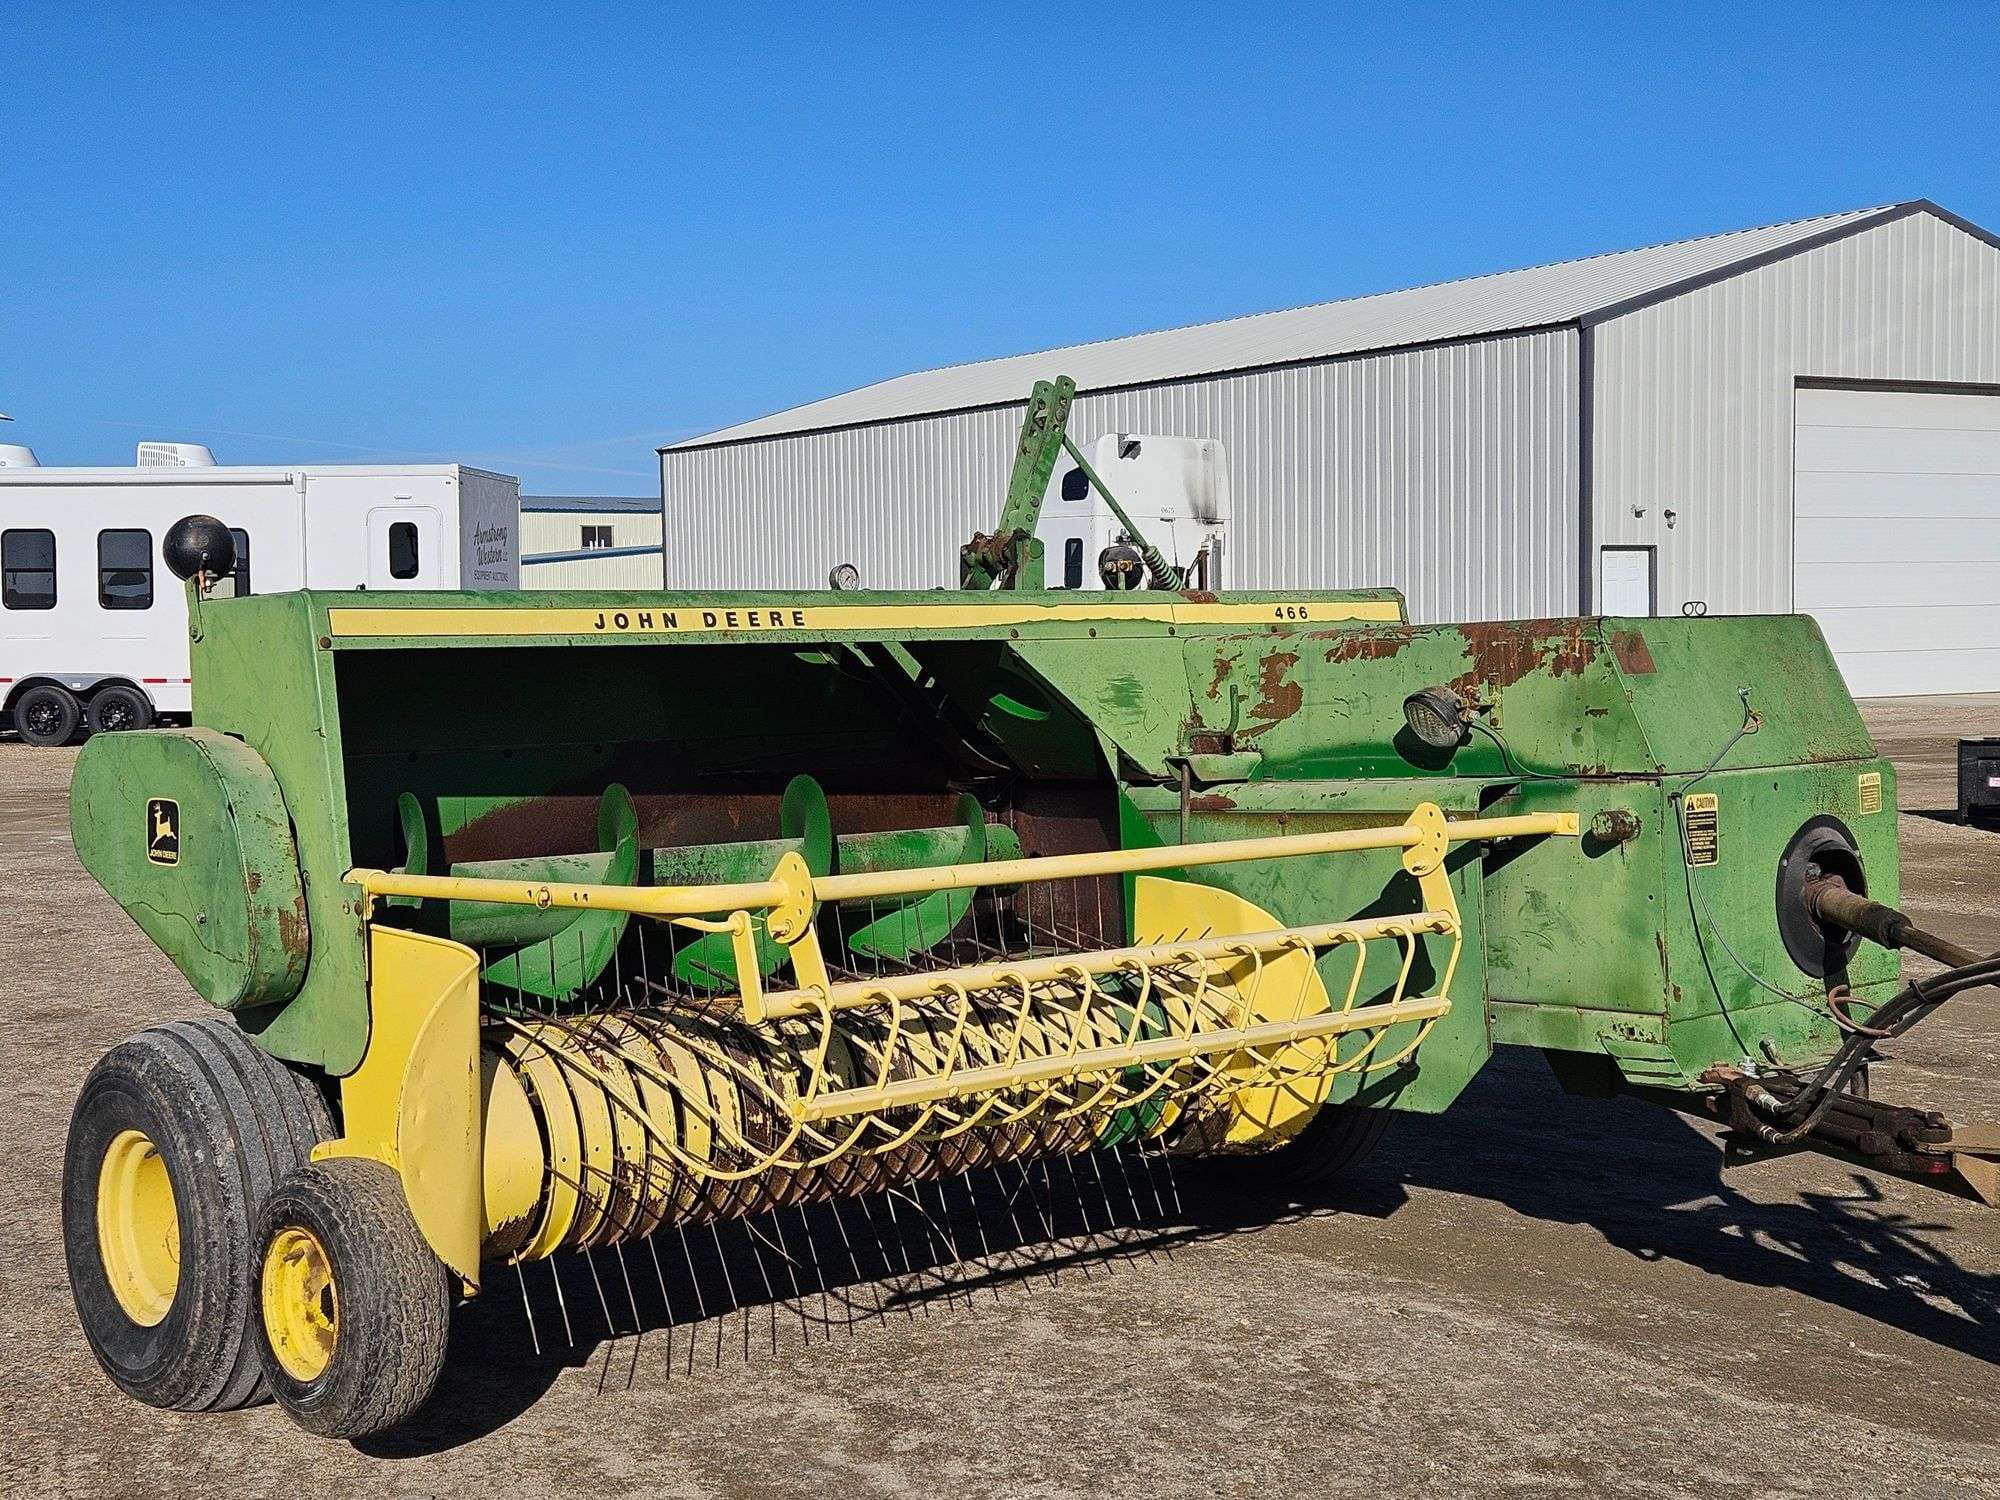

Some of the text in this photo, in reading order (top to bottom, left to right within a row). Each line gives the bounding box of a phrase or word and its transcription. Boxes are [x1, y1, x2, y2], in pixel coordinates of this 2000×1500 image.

[474, 521, 508, 547] Armstrong
[476, 545, 502, 566] Western
[594, 611, 805, 630] JOHN DEERE
[1275, 606, 1308, 620] 466
[1696, 796, 1716, 809] CAUTION
